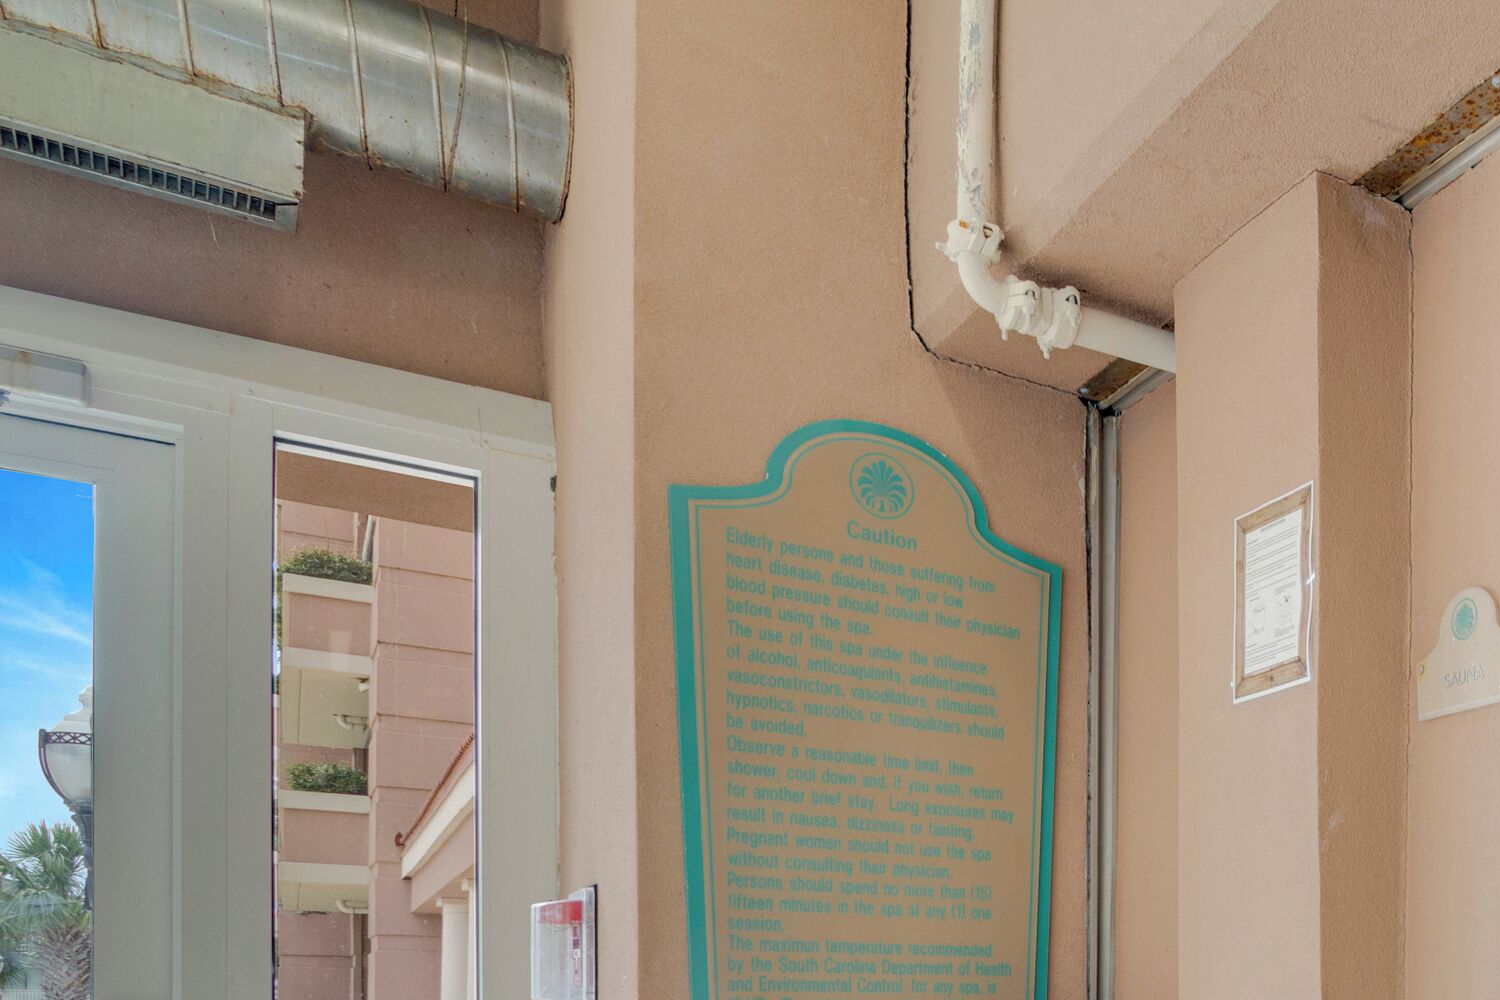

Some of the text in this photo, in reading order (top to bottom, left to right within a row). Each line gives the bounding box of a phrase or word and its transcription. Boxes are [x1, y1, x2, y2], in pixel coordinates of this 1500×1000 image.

[846, 520, 918, 551] Caution
[726, 527, 995, 595] Elderly persons and those suffering from
[725, 550, 763, 573] heart
[895, 583, 922, 604] high
[925, 592, 939, 605] or
[943, 592, 964, 610] low
[726, 573, 1020, 640] blood pressure should consult their physician
[726, 597, 771, 619] before
[778, 608, 814, 631] using
[820, 613, 840, 631] the
[727, 620, 989, 676] The use of this spa under the influence
[727, 644, 740, 660] of
[748, 648, 800, 671] alcohol,
[1443, 664, 1486, 689] SAUNA
[727, 690, 1004, 740] hypnotics, narcotics or tranquilizers should
[727, 713, 807, 737] be avoided.
[727, 736, 784, 757] Observe
[792, 747, 799, 758] a
[805, 749, 876, 767] reasonable
[884, 754, 909, 771] time
[948, 762, 973, 778] then
[787, 768, 816, 782] cool
[822, 769, 856, 786] down
[894, 777, 902, 791] if
[909, 782, 929, 796] you
[969, 786, 1003, 801] return
[727, 782, 747, 798] for
[753, 787, 804, 803] another
[812, 790, 842, 807] brief
[889, 798, 919, 817] Long
[925, 805, 987, 820] exposures
[991, 811, 1014, 826] may
[727, 808, 765, 822] result
[772, 809, 784, 824] in
[847, 816, 904, 834] dizziness
[911, 825, 923, 836] or
[726, 828, 991, 865] Pregnant women should not use the spa
[728, 853, 779, 869] without
[785, 859, 853, 877] consulting
[860, 861, 886, 876] their
[727, 873, 992, 905] Persons should spend no more than (15)
[728, 895, 991, 923] fifteen minutes in the spa at any (1) one
[729, 937, 752, 951] The
[825, 940, 902, 957] temperature
[909, 946, 992, 958] recommended
[727, 957, 1012, 978] by the South Carolina Department of Health
[728, 978, 753, 991] and
[759, 978, 852, 993] Environmental
[912, 981, 927, 994] for
[933, 985, 952, 997] any
[988, 983, 997, 995] is
